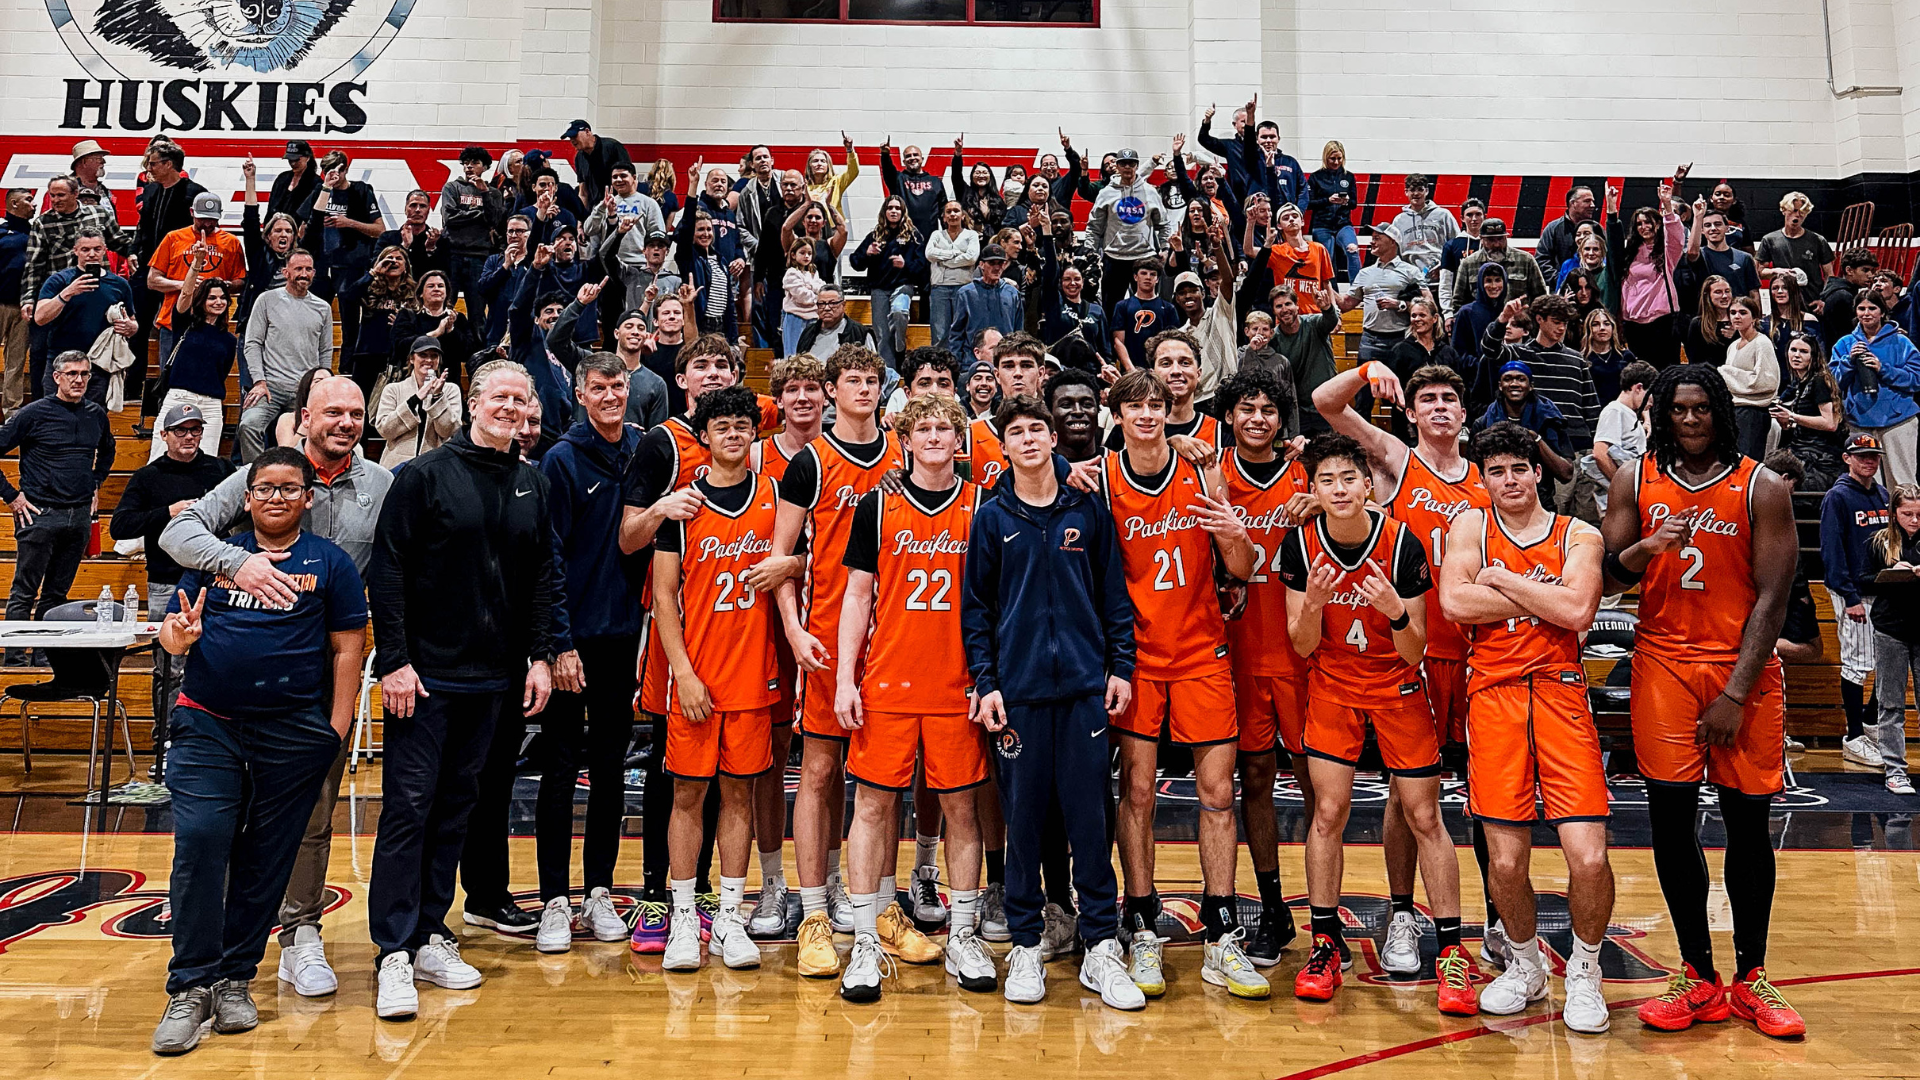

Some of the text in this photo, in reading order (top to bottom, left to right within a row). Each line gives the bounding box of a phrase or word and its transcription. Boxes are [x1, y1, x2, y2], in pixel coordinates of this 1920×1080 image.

[58, 78, 368, 134] HUSKIES
[1118, 206, 1145, 215] NASA
[1284, 278, 1296, 290] THE
[1134, 309, 1157, 334] P
[1063, 527, 1081, 547] P
[1124, 506, 1199, 541] Pacifica
[697, 529, 773, 562] Pacifica
[892, 529, 968, 560] Pacifica
[1153, 545, 1187, 592] 21
[1679, 546, 1706, 592] 2
[713, 568, 757, 612] 23
[905, 568, 952, 612] 22
[1345, 618, 1369, 654] 4
